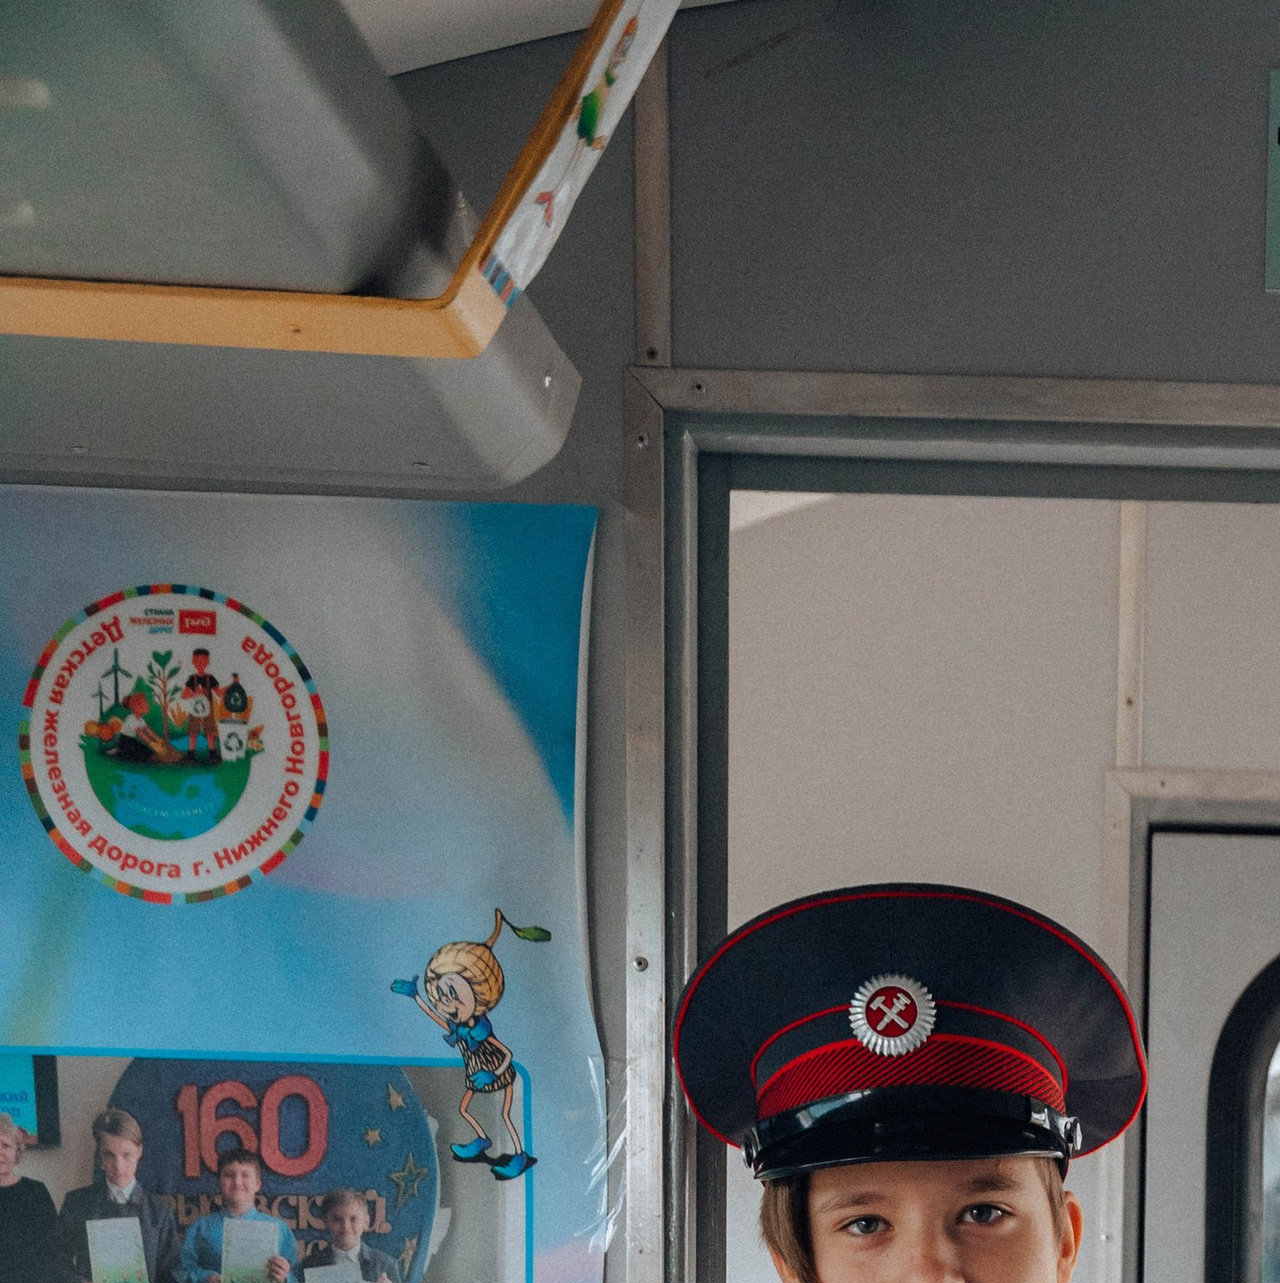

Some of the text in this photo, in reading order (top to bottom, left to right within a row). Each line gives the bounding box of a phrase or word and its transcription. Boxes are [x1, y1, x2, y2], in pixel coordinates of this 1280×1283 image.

[49, 614, 124, 704] Детская
[240, 635, 306, 776] Новгорода
[44, 708, 93, 838] железная
[88, 832, 182, 879] дорога
[192, 860, 212, 877] г.
[213, 779, 300, 870] Нижнего
[176, 1075, 330, 1179] 160
